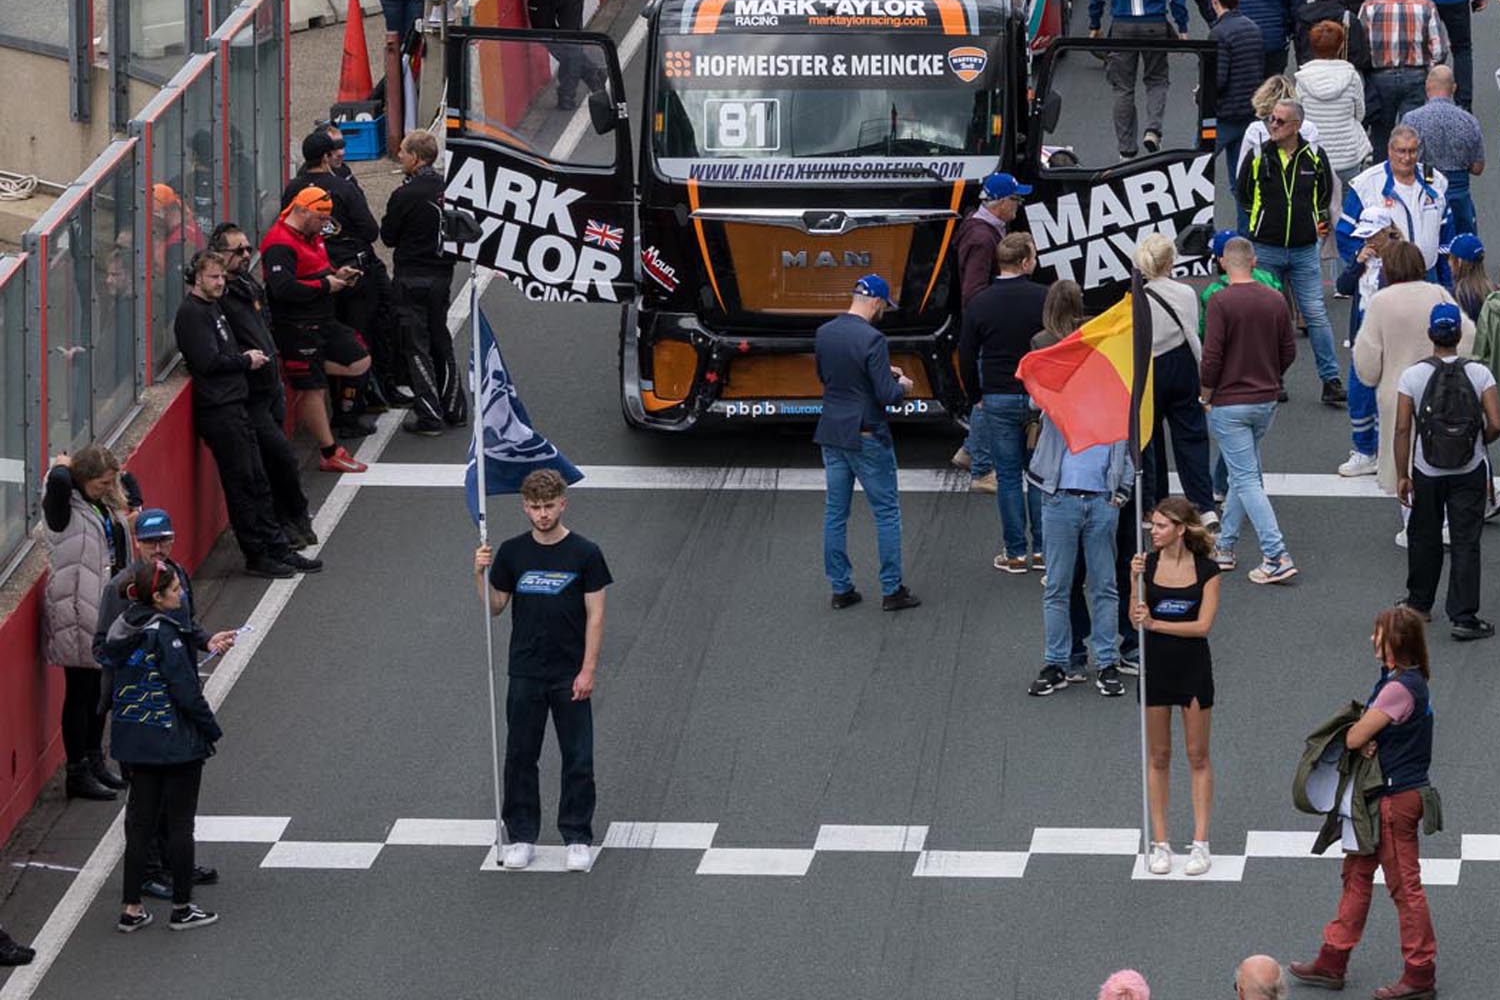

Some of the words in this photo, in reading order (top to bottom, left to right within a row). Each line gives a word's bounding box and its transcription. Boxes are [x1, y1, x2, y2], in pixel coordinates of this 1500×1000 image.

[734, 0, 822, 16] MARK
[824, 0, 926, 16] TAYLOR
[735, 16, 778, 26] RACING
[808, 16, 927, 27] marktaylorracing.com
[696, 55, 829, 76] HOFMEISTER
[832, 56, 847, 75] &
[852, 56, 944, 76] MEINCKE
[719, 102, 768, 147] 81
[445, 149, 586, 238] ARK
[1025, 153, 1215, 251] MARK
[781, 250, 872, 267] MAN
